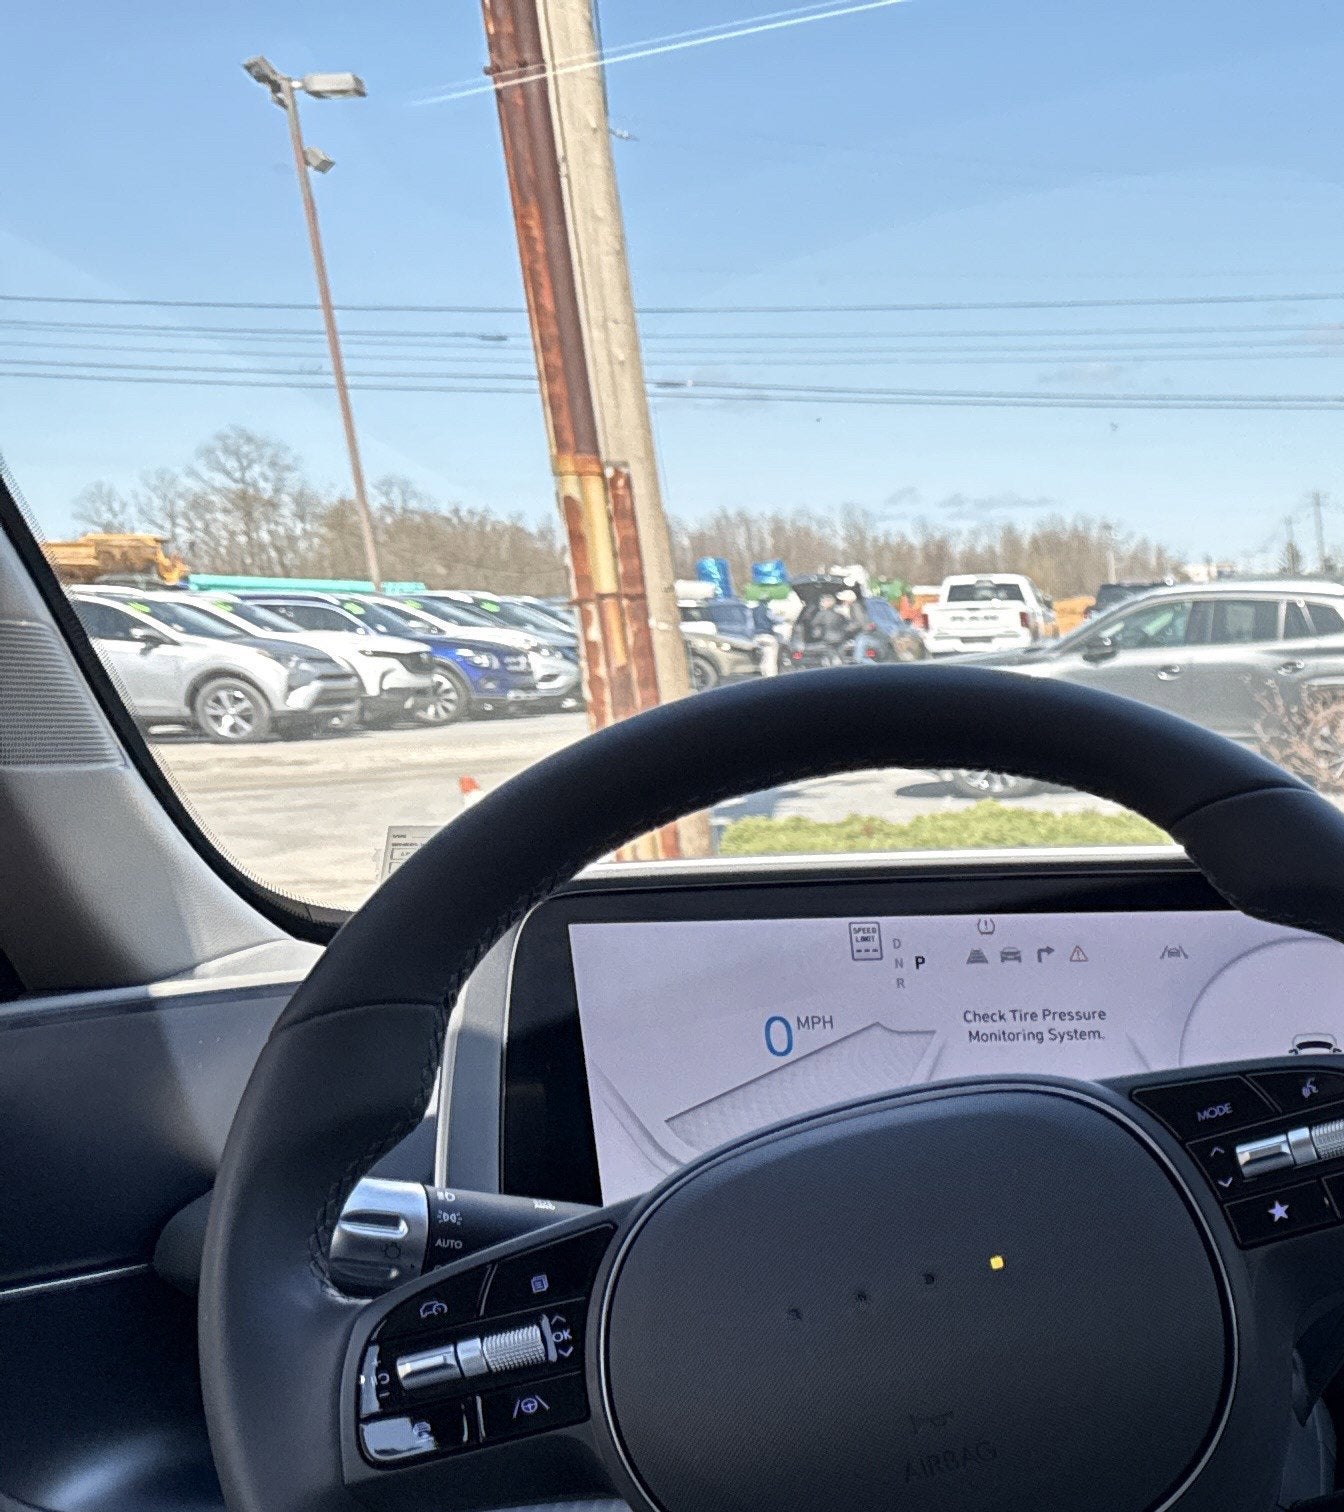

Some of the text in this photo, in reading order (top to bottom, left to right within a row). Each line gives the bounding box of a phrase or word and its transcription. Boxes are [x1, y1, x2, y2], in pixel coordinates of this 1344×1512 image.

[853, 927, 877, 935] SPEED
[892, 938, 902, 949] D
[894, 955, 926, 970] N P
[896, 978, 906, 989] R
[963, 1007, 1107, 1024] Check Tire Pressure
[763, 1013, 834, 1057] 0 MPH
[968, 1028, 1106, 1045] Monitoring System.
[1197, 1102, 1235, 1122] MODE
[435, 1238, 463, 1250] AUTO
[553, 1328, 572, 1343] OK
[904, 1441, 997, 1483] AIRBAG
